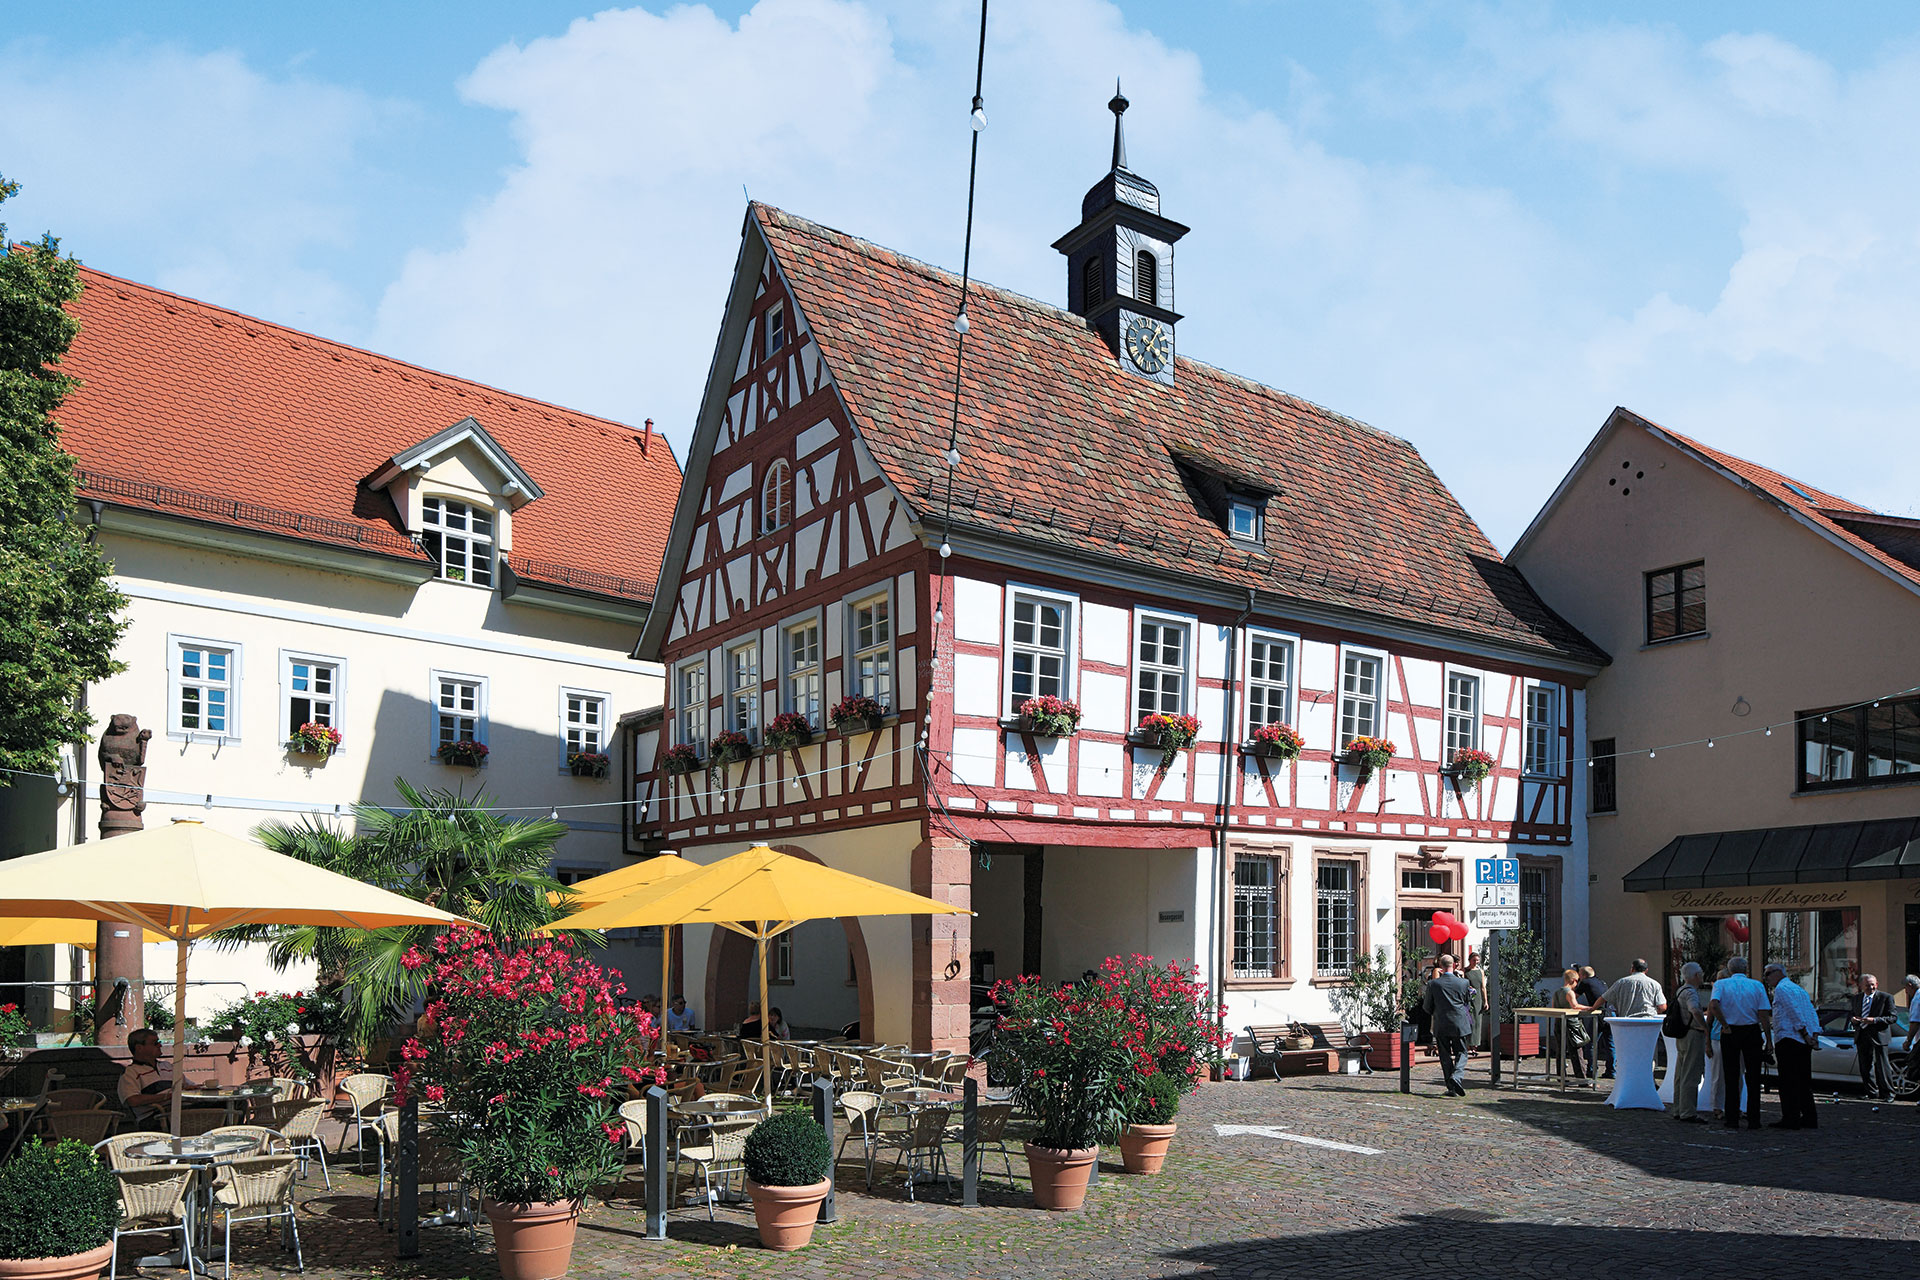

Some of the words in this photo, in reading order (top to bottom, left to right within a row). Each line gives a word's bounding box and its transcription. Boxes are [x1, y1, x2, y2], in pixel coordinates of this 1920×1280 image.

[1480, 862, 1491, 881] P
[1503, 861, 1512, 877] P
[1670, 887, 1848, 909] Rathaus-Metzgerei
